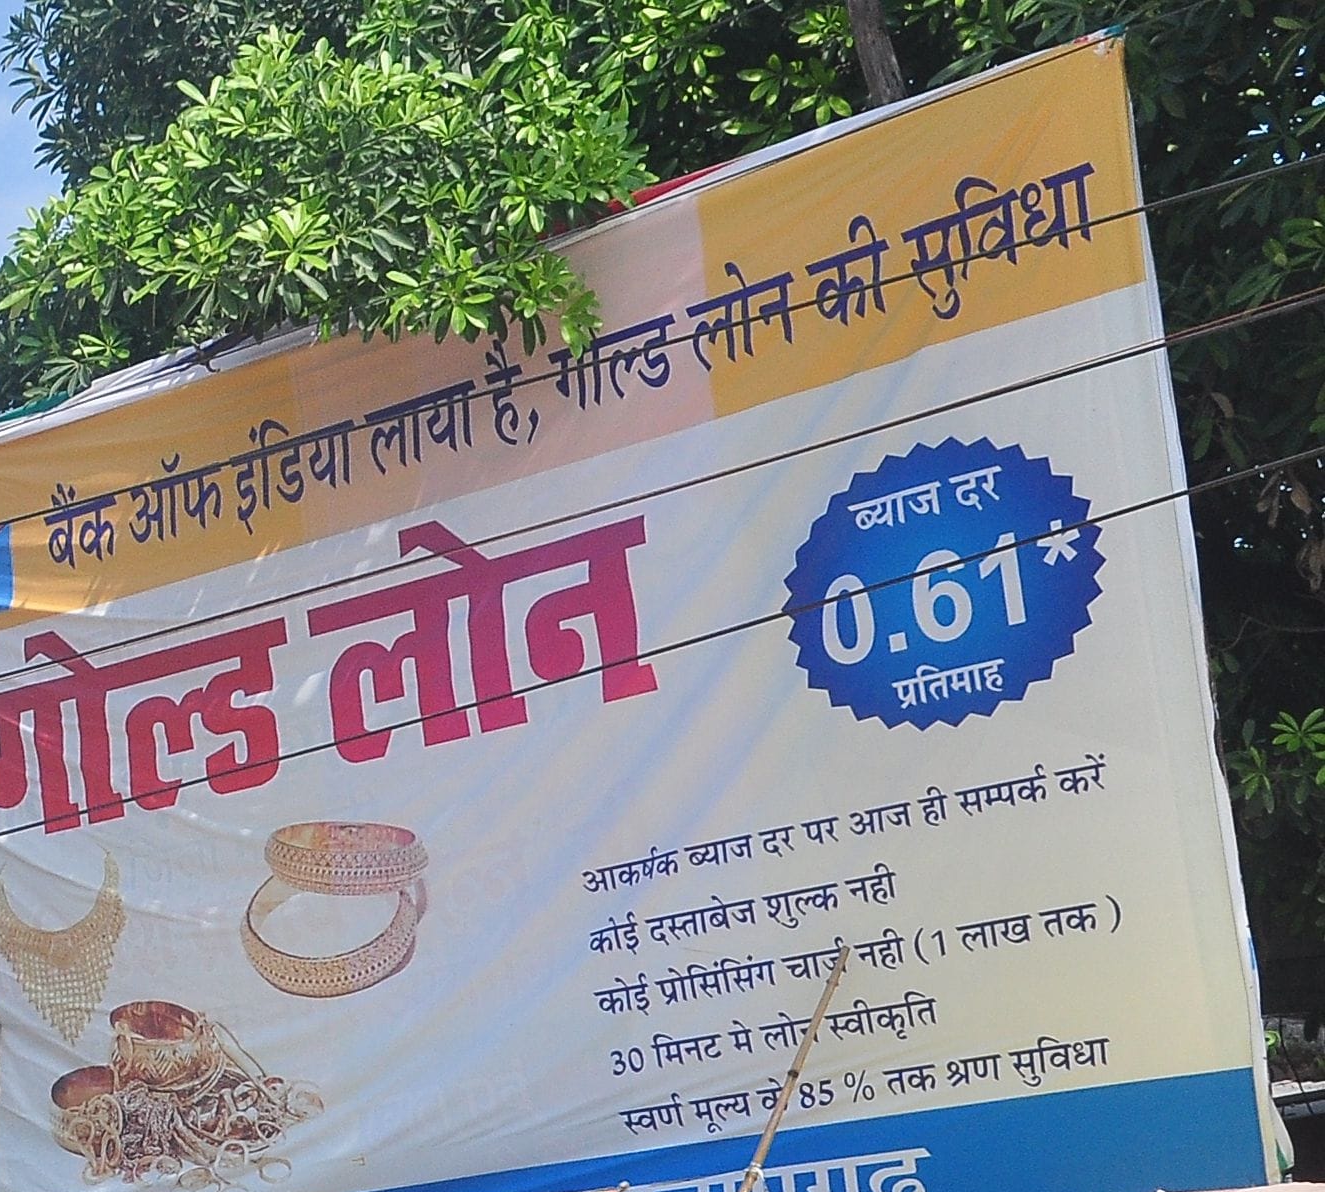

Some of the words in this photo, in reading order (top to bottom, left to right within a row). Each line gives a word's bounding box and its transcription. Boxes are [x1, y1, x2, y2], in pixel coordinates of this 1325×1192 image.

[44, 481, 119, 569] बैंक
[128, 456, 224, 544] ऑफ
[228, 417, 353, 536] इंडिया
[365, 385, 474, 472] लाया
[685, 261, 793, 370] लोन
[806, 215, 887, 326] की
[900, 161, 1094, 321] सुविधा
[849, 472, 943, 533] ब्याज
[949, 463, 1002, 513] दर
[306, 512, 659, 765] लोन
[891, 658, 1005, 710] प्रतिमाह
[582, 847, 680, 896] आकर्षक
[685, 833, 753, 878] ब्याज
[758, 825, 797, 870] दर
[802, 816, 840, 849] पर
[850, 801, 913, 836] आज
[917, 789, 948, 827] ही
[955, 764, 1048, 817] सम्पर्क
[1055, 752, 1110, 796] करें
[588, 909, 642, 956] कोई
[764, 883, 840, 931] शुल्क
[845, 867, 897, 909] नही
[594, 970, 653, 1018] कोई
[854, 928, 905, 972] नही
[956, 911, 1032, 952] लाख
[1043, 904, 1099, 941] तक
[609, 1044, 647, 1078] 30
[652, 1030, 722, 1070] मिनट
[728, 1018, 755, 1056] मे
[823, 992, 939, 1046] स्वीकृति
[621, 1093, 687, 1137] स्वर्ण
[693, 1081, 751, 1133] मूल्य
[798, 1077, 835, 1111] 85
[843, 1072, 876, 1102] %
[882, 1060, 937, 1098] तक
[1009, 1035, 1110, 1088] सुविधा
